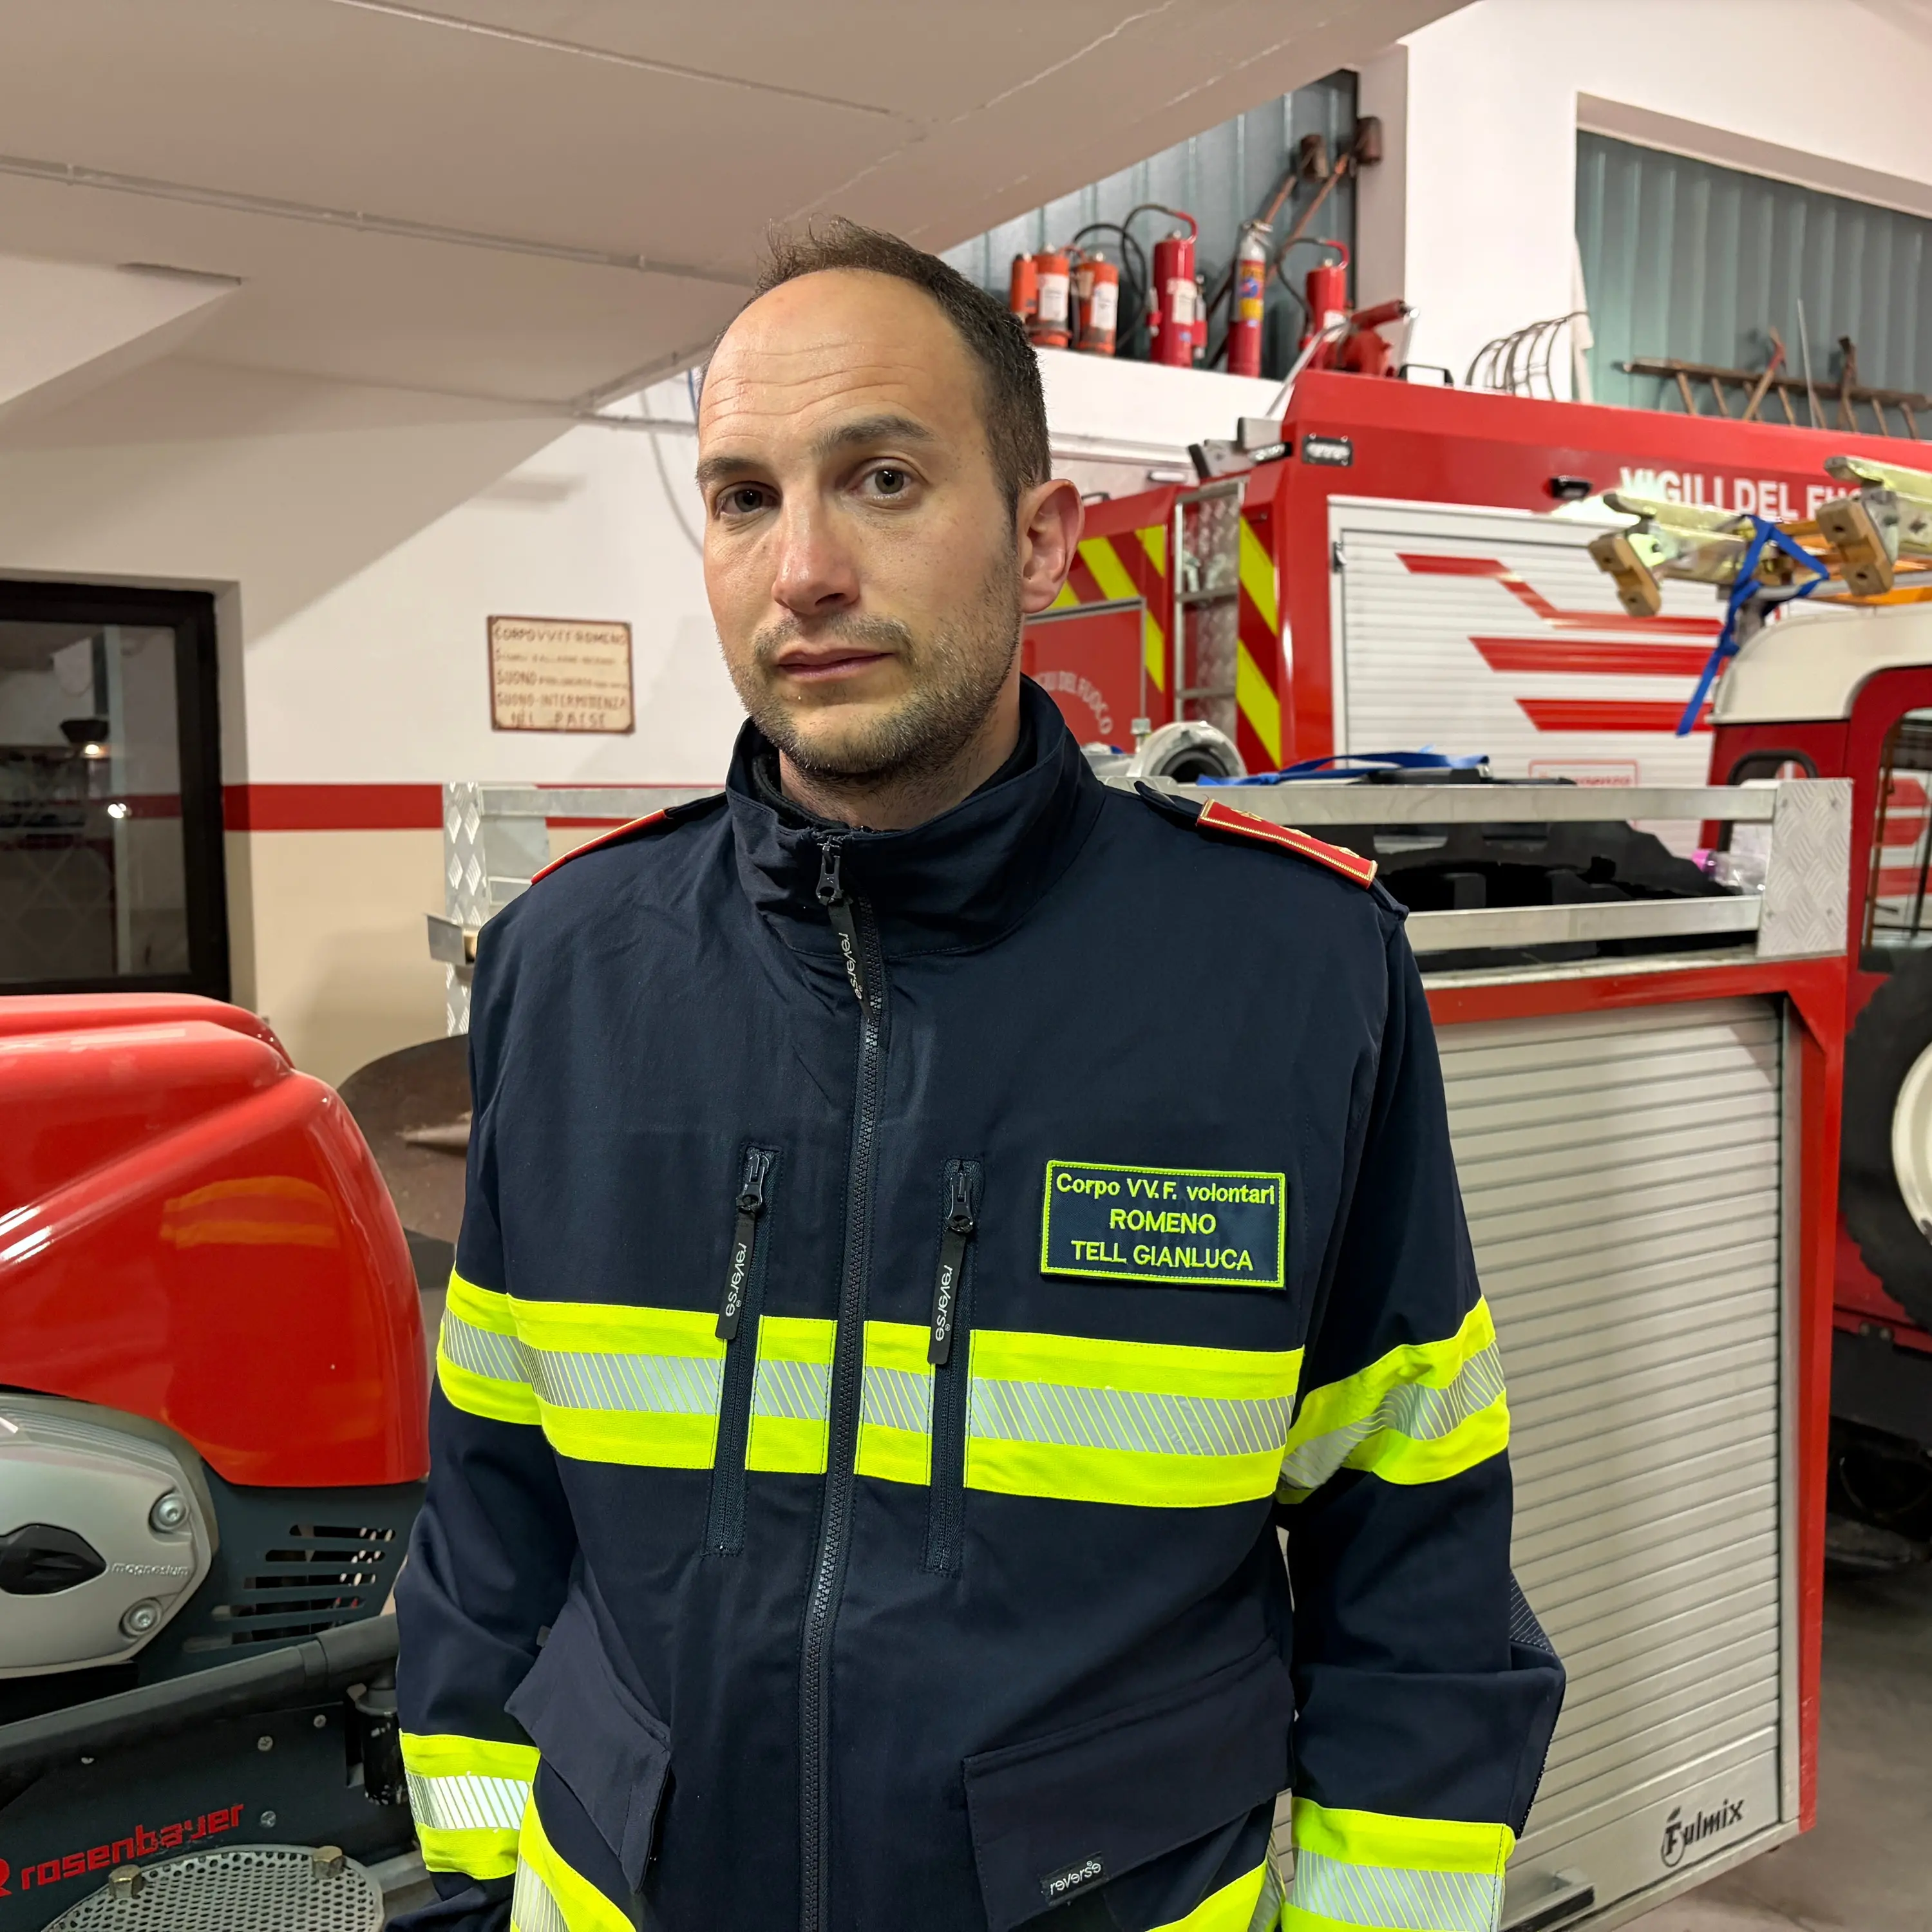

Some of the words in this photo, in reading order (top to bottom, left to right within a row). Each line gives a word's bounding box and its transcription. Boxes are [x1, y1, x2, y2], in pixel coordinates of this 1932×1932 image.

[1734, 478, 1799, 520] DEL
[838, 932, 864, 999] reverse
[1056, 1173, 1121, 1199] Corpo
[1186, 1182, 1276, 1205] volontari
[1109, 1208, 1217, 1235] ROMENO
[1070, 1240, 1127, 1264] TELL
[1133, 1244, 1255, 1271] GIANLUCA
[725, 1242, 748, 1317] reverse
[935, 1264, 954, 1341] reverse
[1050, 1861, 1102, 1895] reverse
